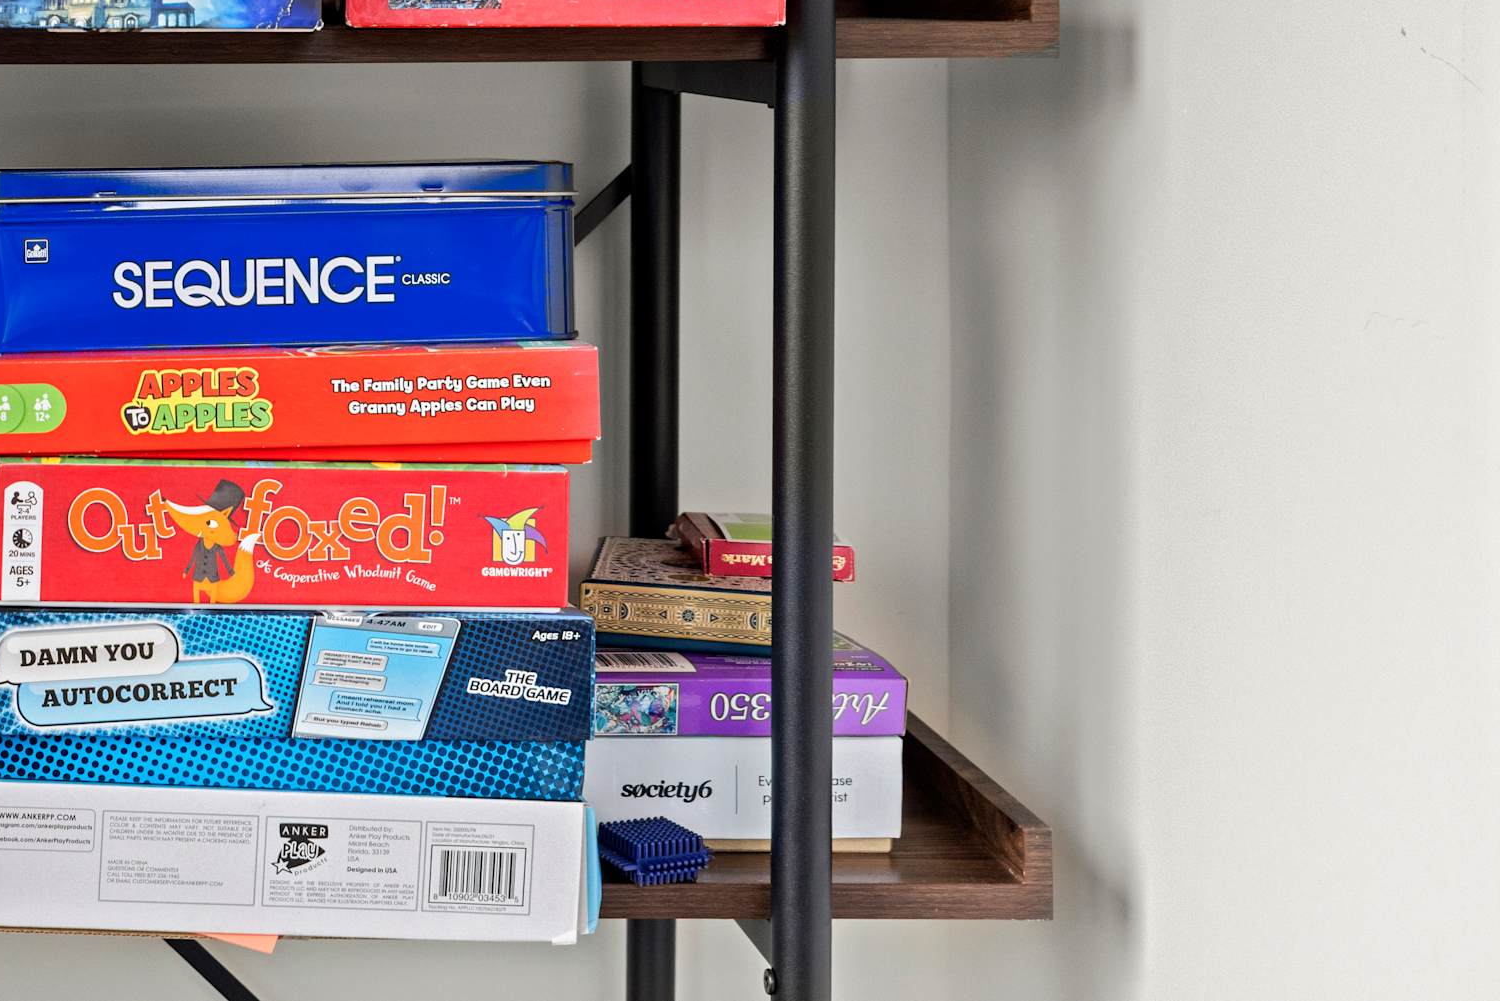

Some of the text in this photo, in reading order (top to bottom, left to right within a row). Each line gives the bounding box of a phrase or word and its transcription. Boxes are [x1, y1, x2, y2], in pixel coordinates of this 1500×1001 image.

[113, 256, 450, 309] SEQUENCE CLASSIC
[138, 370, 257, 400] APPLES
[331, 374, 551, 394] The Family Party Game Even
[152, 401, 271, 431] APPLES
[348, 396, 535, 417] Granny Apples Can Play
[35, 412, 50, 422] 12+
[9, 566, 34, 575] AGES
[274, 566, 340, 588] Cooperative
[344, 566, 401, 580] Whodunit
[406, 571, 436, 592] Game
[16, 577, 31, 587] 5+
[532, 631, 581, 642] Ages 18+
[20, 642, 155, 667] DAMN YOU
[506, 672, 535, 686] THE
[42, 678, 238, 708] AUTOCORRECT
[470, 680, 570, 703] BOARD GAME
[710, 693, 771, 721] 350
[282, 826, 326, 837] ANKER
[294, 857, 328, 876] products
[347, 866, 375, 874] Designed
[448, 893, 475, 901] 10902
